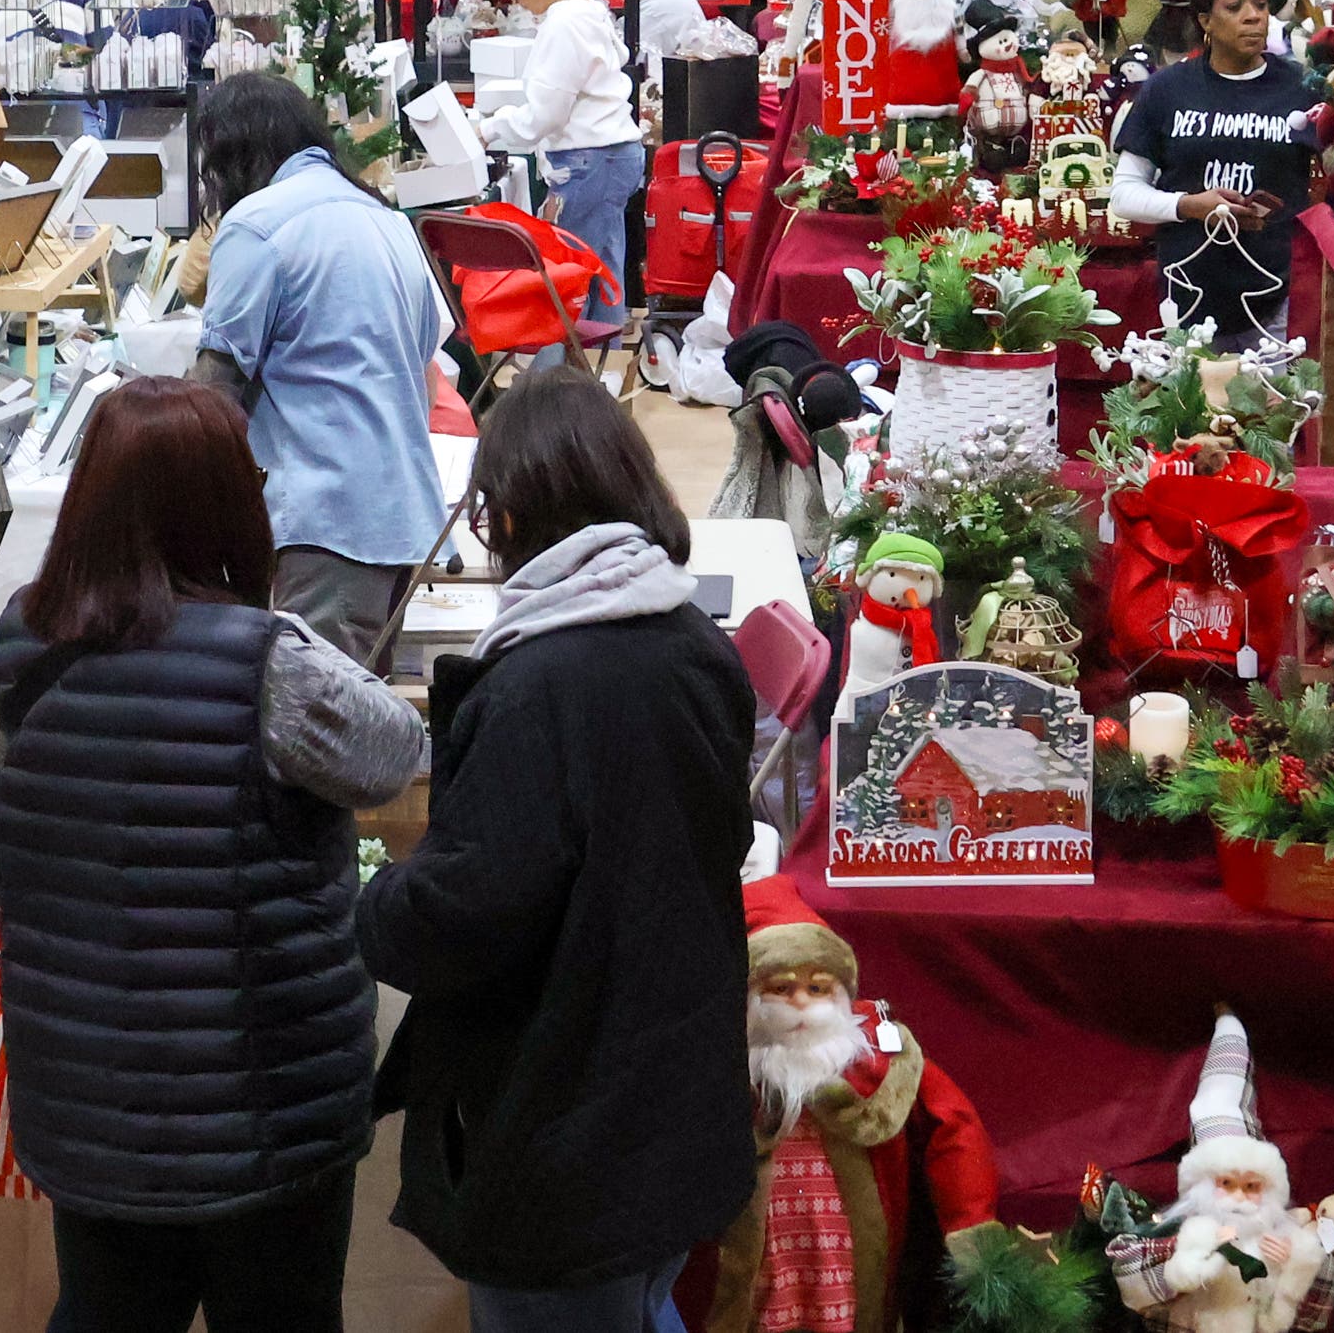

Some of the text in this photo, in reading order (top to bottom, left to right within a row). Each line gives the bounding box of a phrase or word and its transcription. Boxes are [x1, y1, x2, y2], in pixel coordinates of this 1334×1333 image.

[835, 0, 876, 124] NOEL
[1171, 110, 1292, 143] DEE'S HOMEMADE
[1203, 159, 1255, 195] CRAFTS
[949, 824, 1093, 863] GREETINGS
